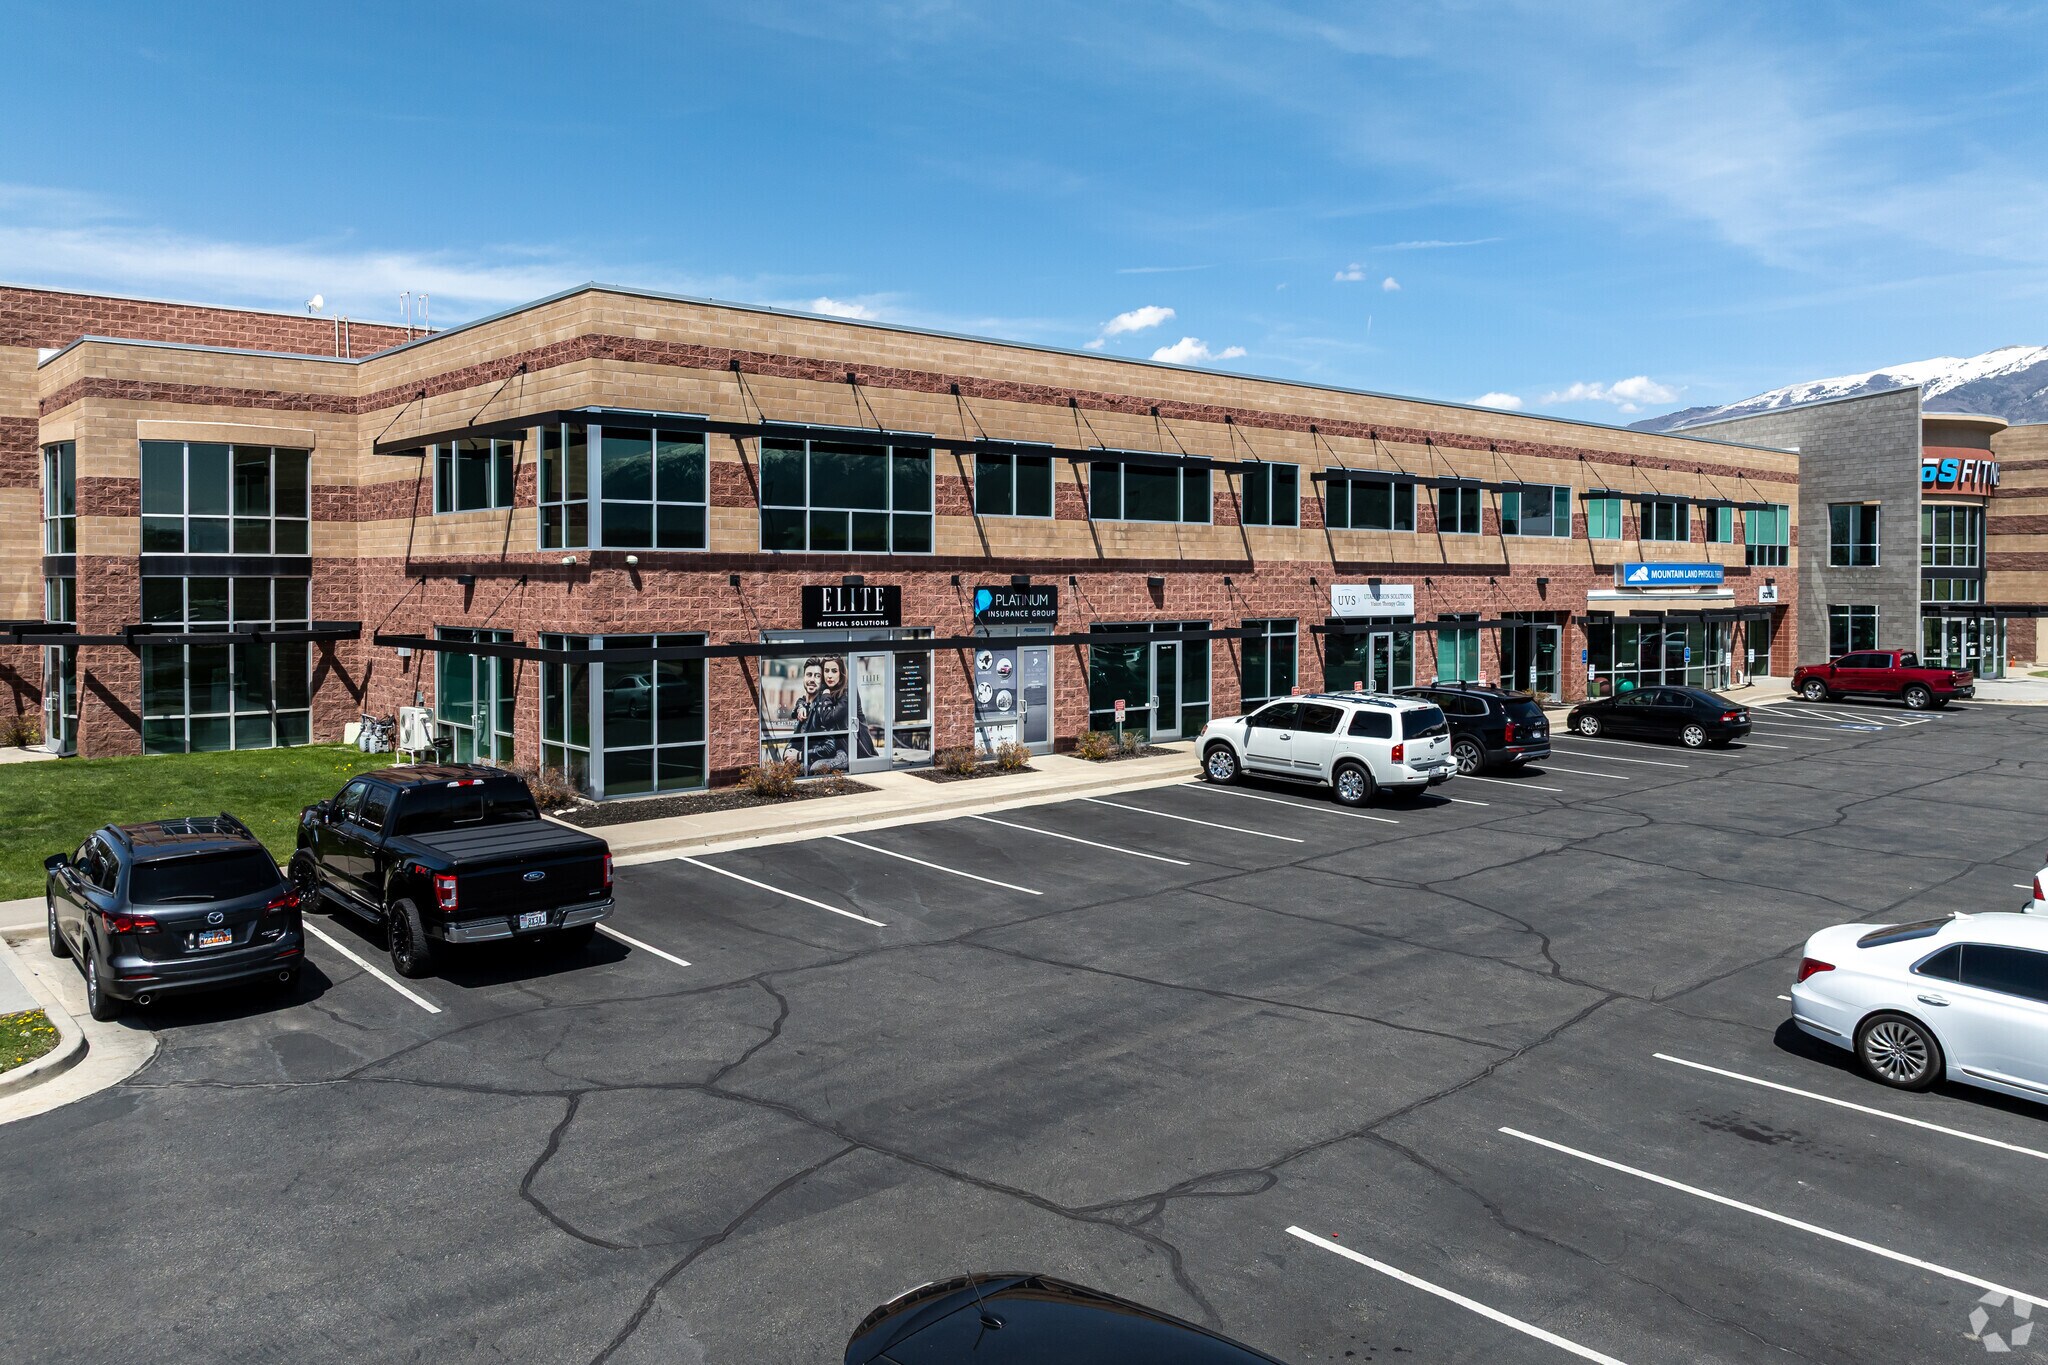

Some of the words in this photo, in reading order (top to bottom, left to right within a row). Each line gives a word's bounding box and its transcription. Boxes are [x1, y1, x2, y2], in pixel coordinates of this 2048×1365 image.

[1651, 569, 1684, 579] MOUNTAIN
[1684, 569, 1698, 579] LAND
[822, 587, 884, 612] ELITE
[995, 593, 1049, 606] PLATINUM
[1338, 595, 1356, 606] UVS
[987, 610, 1029, 618] INSURANCE
[1031, 609, 1056, 617] GROUP
